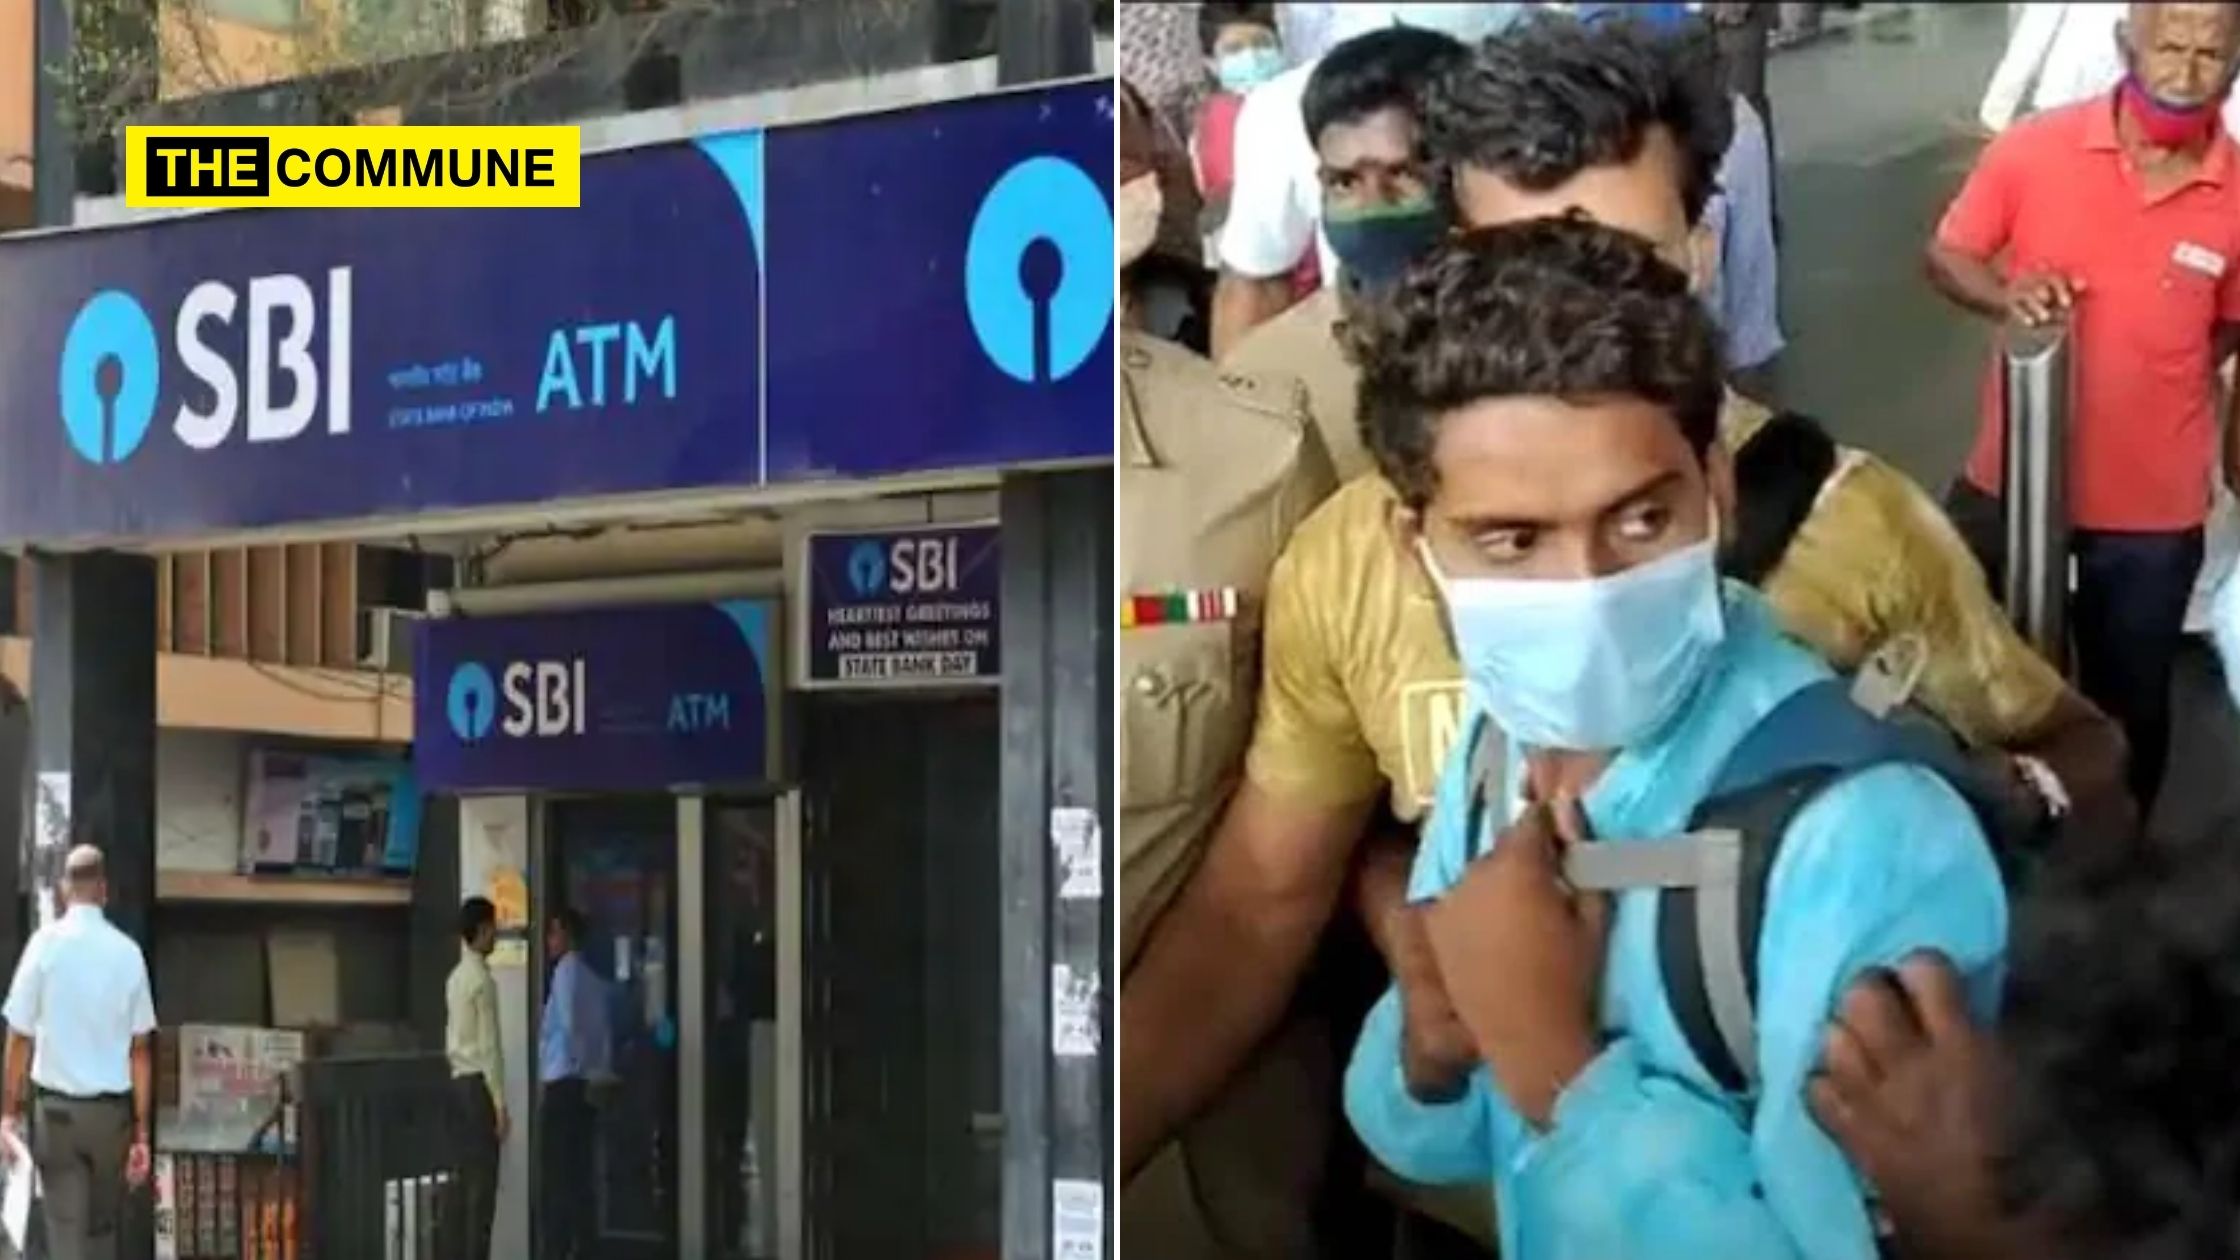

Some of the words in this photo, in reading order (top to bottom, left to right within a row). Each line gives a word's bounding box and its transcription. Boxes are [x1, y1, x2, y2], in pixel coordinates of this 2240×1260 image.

[173, 266, 353, 450] SBI
[535, 316, 677, 412] ATM
[889, 537, 958, 593] SBI
[904, 601, 990, 622] GREETINGS
[828, 631, 861, 650] AND
[864, 630, 899, 649] BEST
[963, 628, 990, 645] ON
[844, 656, 886, 678] STATE
[942, 654, 973, 675] DAY
[502, 658, 586, 738] SBI
[667, 694, 731, 730] ATM
